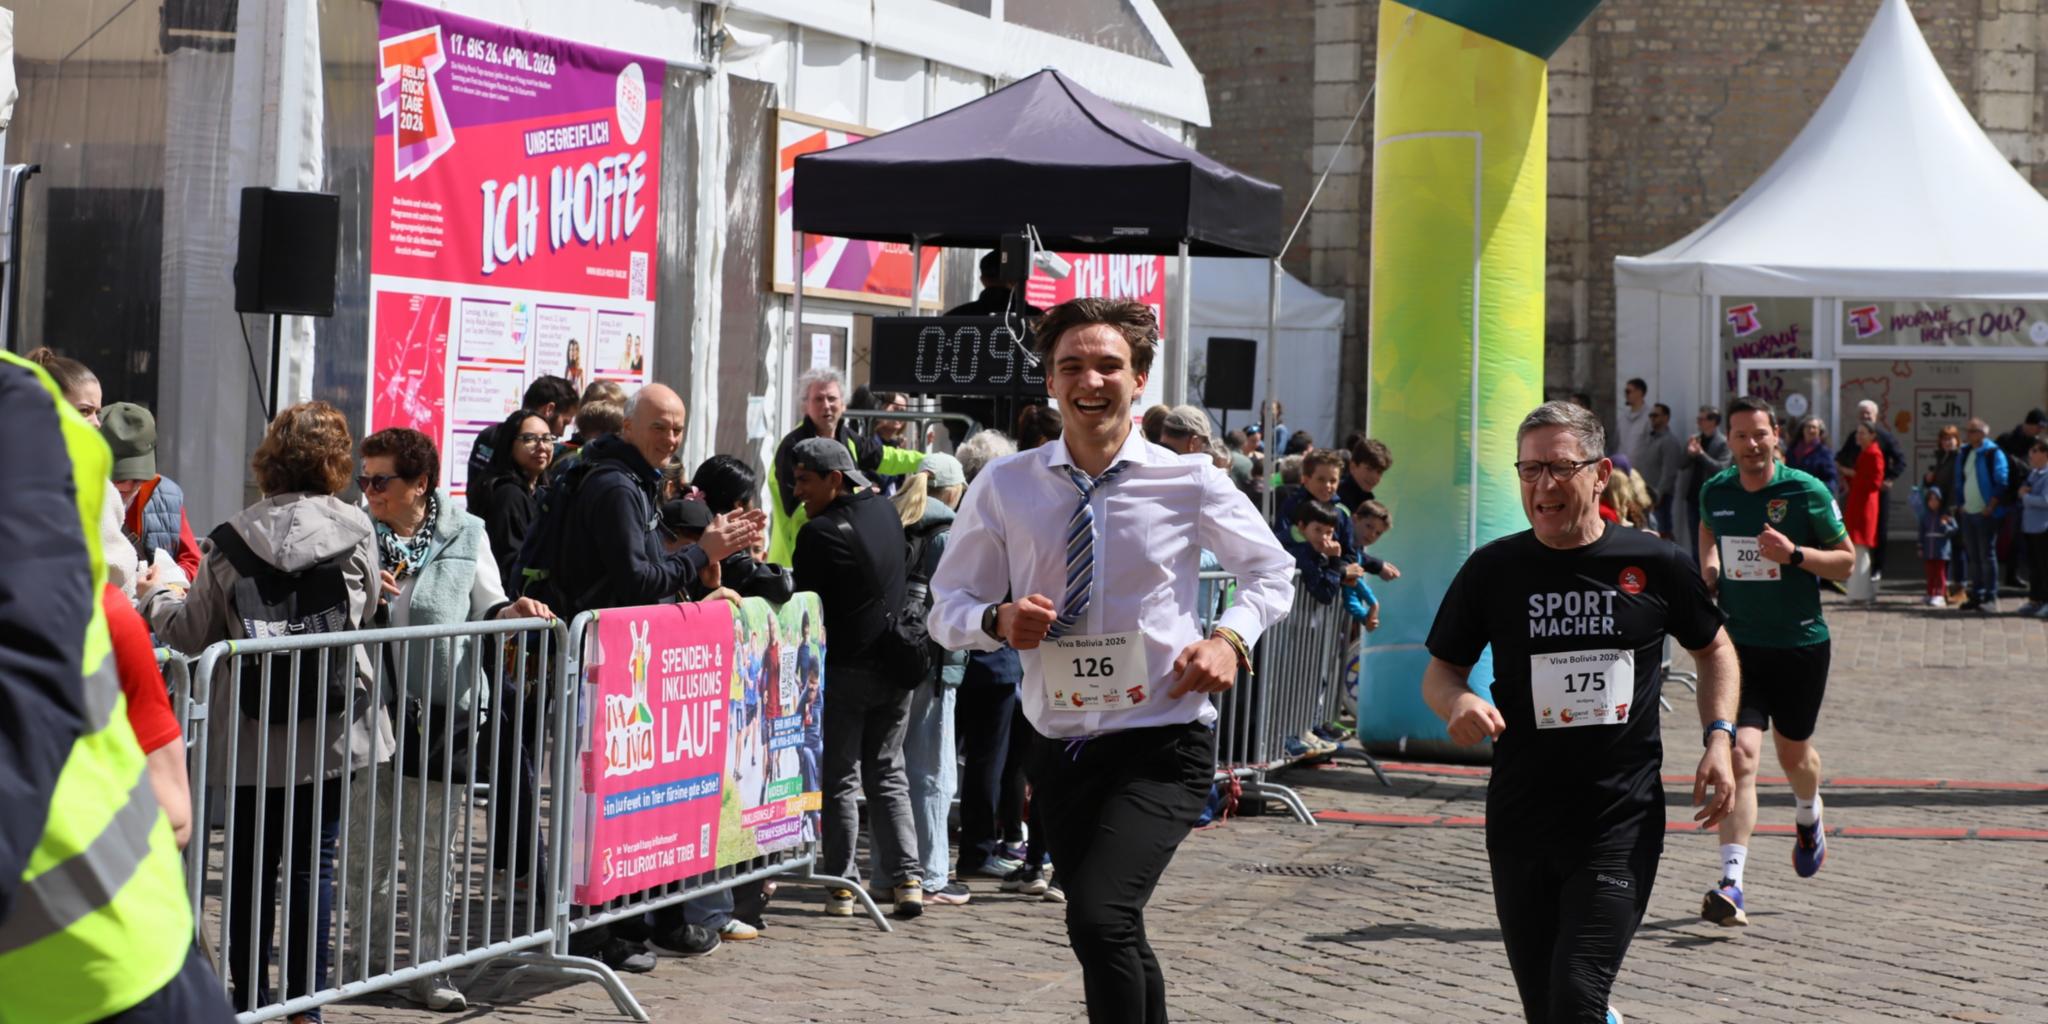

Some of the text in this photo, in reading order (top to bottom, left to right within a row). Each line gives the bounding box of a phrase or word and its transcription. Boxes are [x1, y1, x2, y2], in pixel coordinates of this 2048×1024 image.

[450, 34, 556, 76] 17. BIS 26. APRIL 2026
[401, 78, 424, 96] ROCK
[400, 94, 424, 113] TAGE
[400, 112, 424, 132] 2026
[525, 121, 610, 155] UNBEGREIFLICH
[480, 150, 647, 275] ICH HOFFE
[1921, 402, 1968, 418] 3. Jh.
[1737, 550, 1761, 562] 202
[1528, 590, 1617, 618] SPORT
[1530, 616, 1622, 638] MACHER.
[1056, 636, 1126, 648] Viva Bolivia 2026
[662, 643, 722, 674] SPENDEN- &
[1072, 656, 1114, 678] 126
[1550, 653, 1620, 665] Viva Bolivia 2026
[662, 671, 722, 702] INKLUSIONS
[1564, 672, 1606, 694] 175
[662, 698, 722, 764] LAUF
